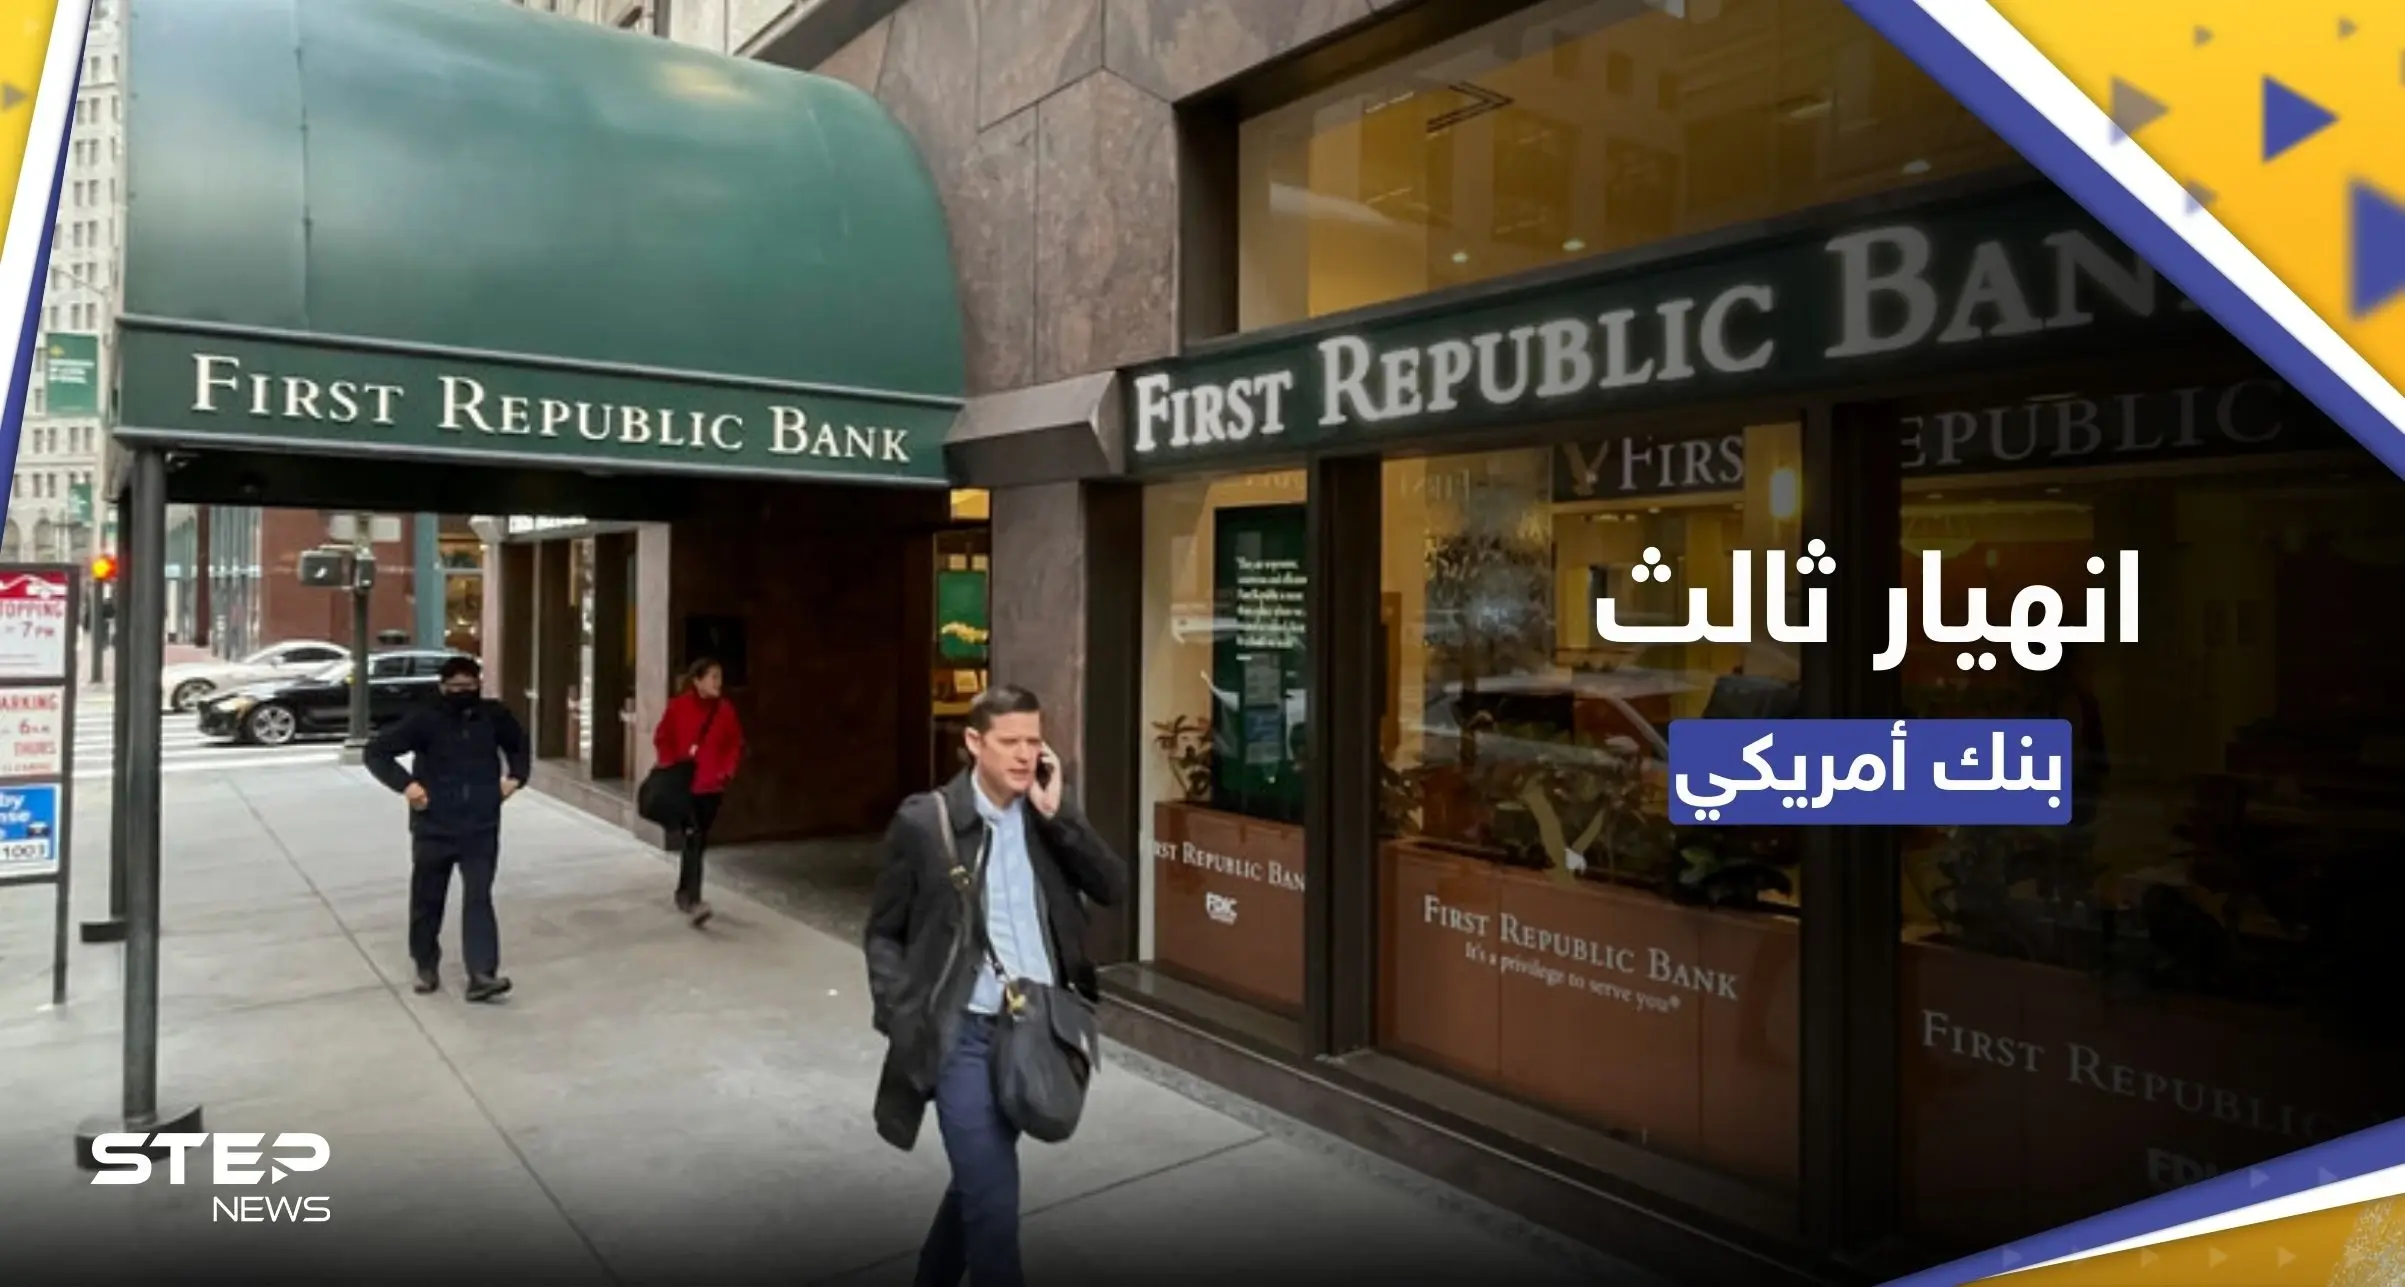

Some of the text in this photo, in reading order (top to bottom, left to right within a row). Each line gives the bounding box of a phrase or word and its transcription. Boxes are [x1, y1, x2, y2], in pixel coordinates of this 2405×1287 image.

[1133, 225, 2198, 452] FIRST REPUBLIC BAN
[191, 353, 911, 463] FIRST REPUBLIC BANK
[1182, 841, 1264, 881] REPUBLIC
[1423, 894, 1739, 1001] FIRST REPUBLIC BANK
[1501, 954, 1565, 986] privilege
[1568, 973, 1585, 990] to
[1588, 979, 1633, 1002] serve
[1921, 1008, 2046, 1074] FIRST
